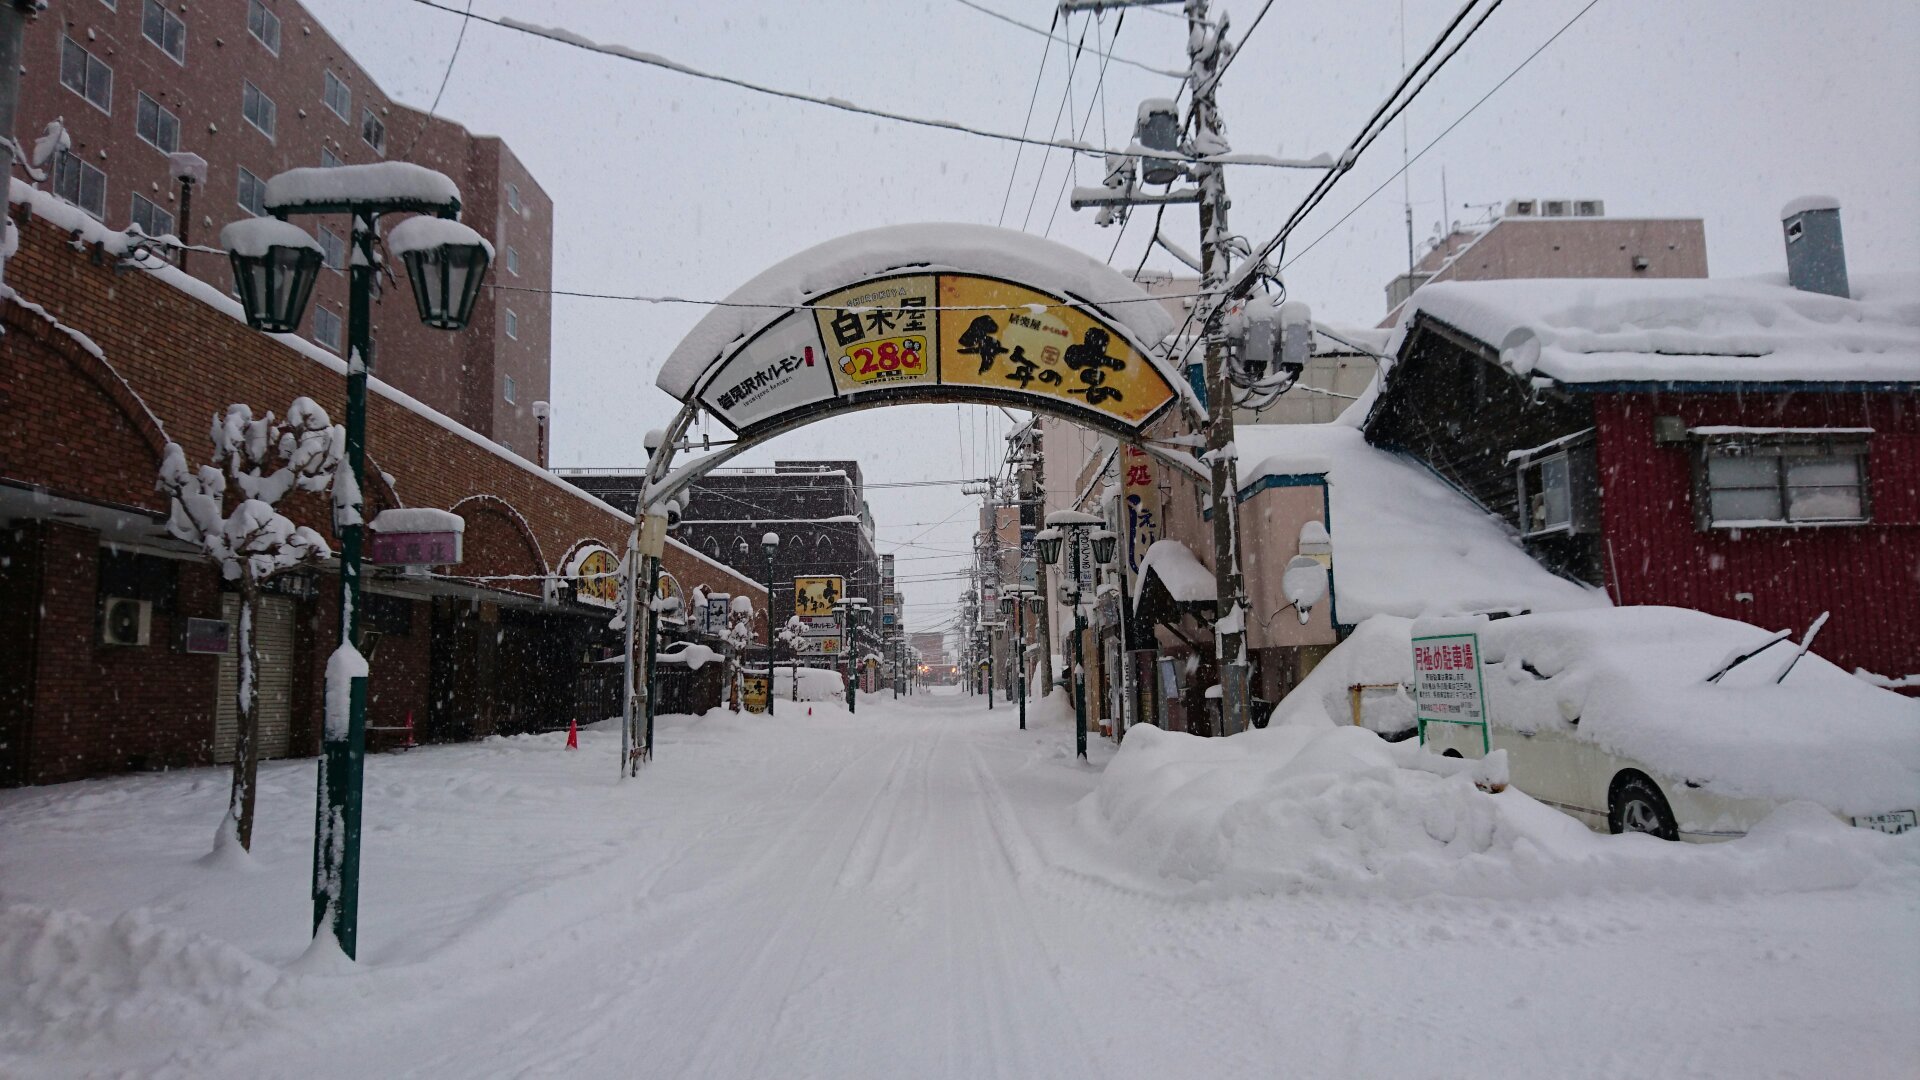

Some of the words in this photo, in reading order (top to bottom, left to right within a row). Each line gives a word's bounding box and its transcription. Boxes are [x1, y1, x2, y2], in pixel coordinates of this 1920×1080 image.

[831, 296, 927, 347] 白木屋
[847, 287, 907, 307] SHIROKIYA
[717, 355, 804, 411] 岩見沢ホルモン
[957, 314, 1126, 405] 千年の宴
[1414, 643, 1474, 671] 月極め駐車場
